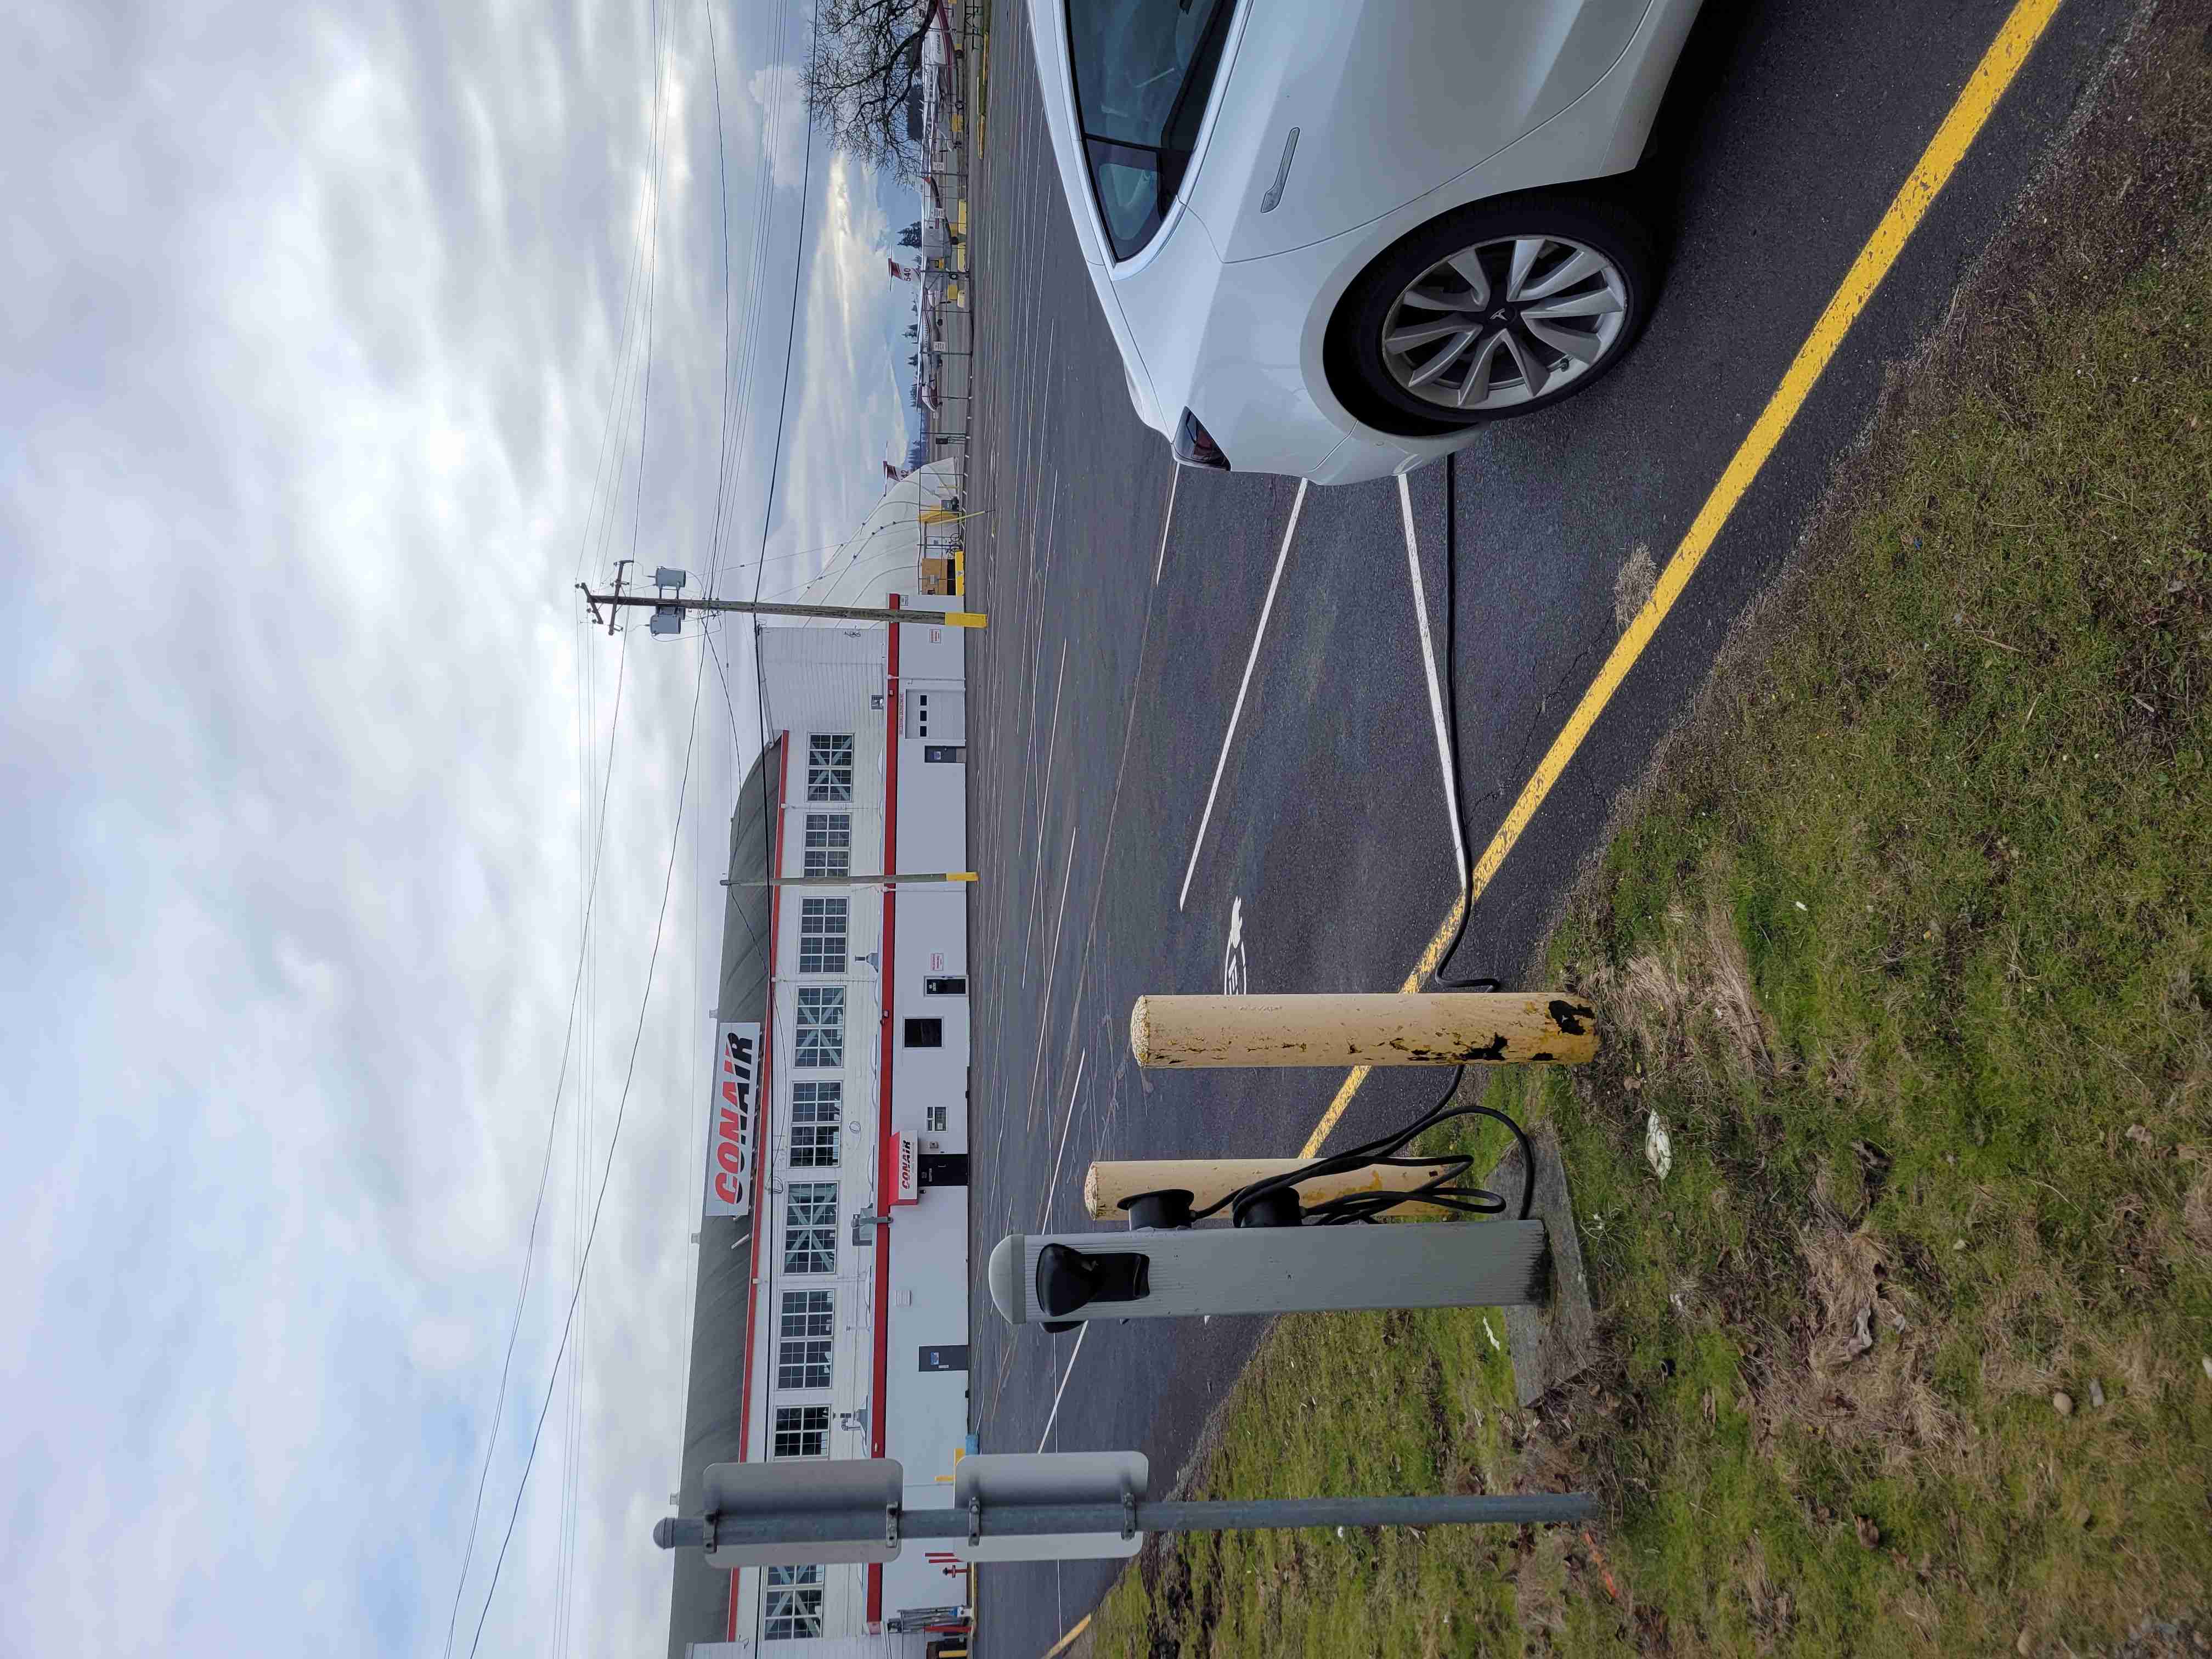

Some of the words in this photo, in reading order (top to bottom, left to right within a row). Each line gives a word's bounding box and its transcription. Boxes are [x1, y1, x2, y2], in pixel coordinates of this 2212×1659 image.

[900, 470, 909, 480] 42
[715, 1032, 753, 1204] CONAIR
[902, 1140, 910, 1189] CONAIR
